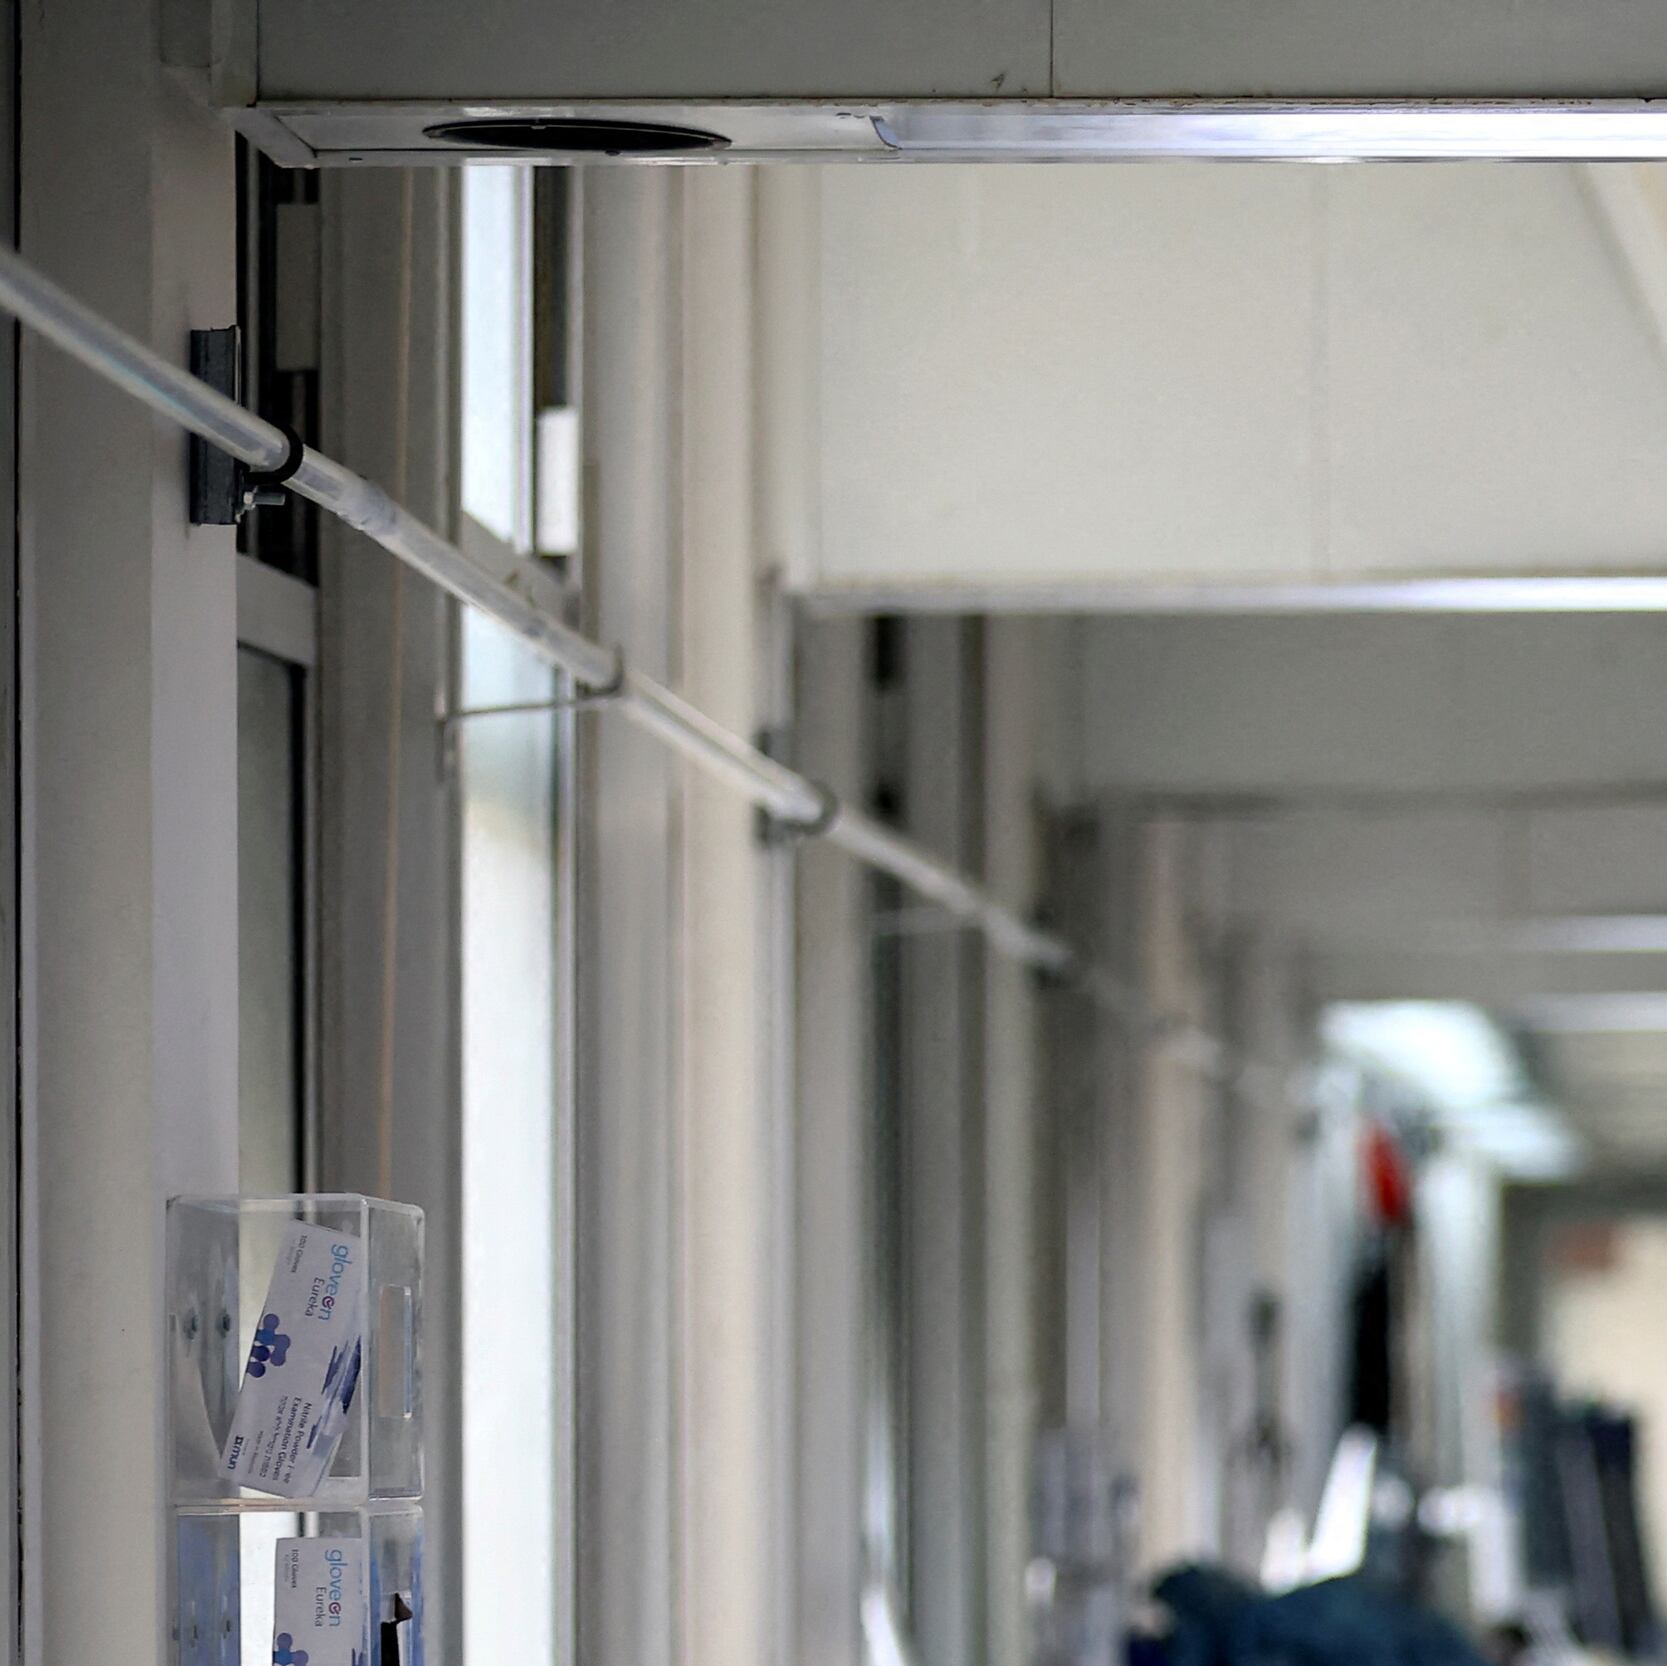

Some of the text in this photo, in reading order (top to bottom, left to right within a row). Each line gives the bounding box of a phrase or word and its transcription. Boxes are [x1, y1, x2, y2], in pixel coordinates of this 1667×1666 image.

[305, 1277, 325, 1317] Eureka
[299, 1402, 312, 1429] Nitrile
[272, 1397, 302, 1481] Examination Gloves
[289, 1431, 305, 1463] Powder
[315, 1586, 327, 1627] Eureka
